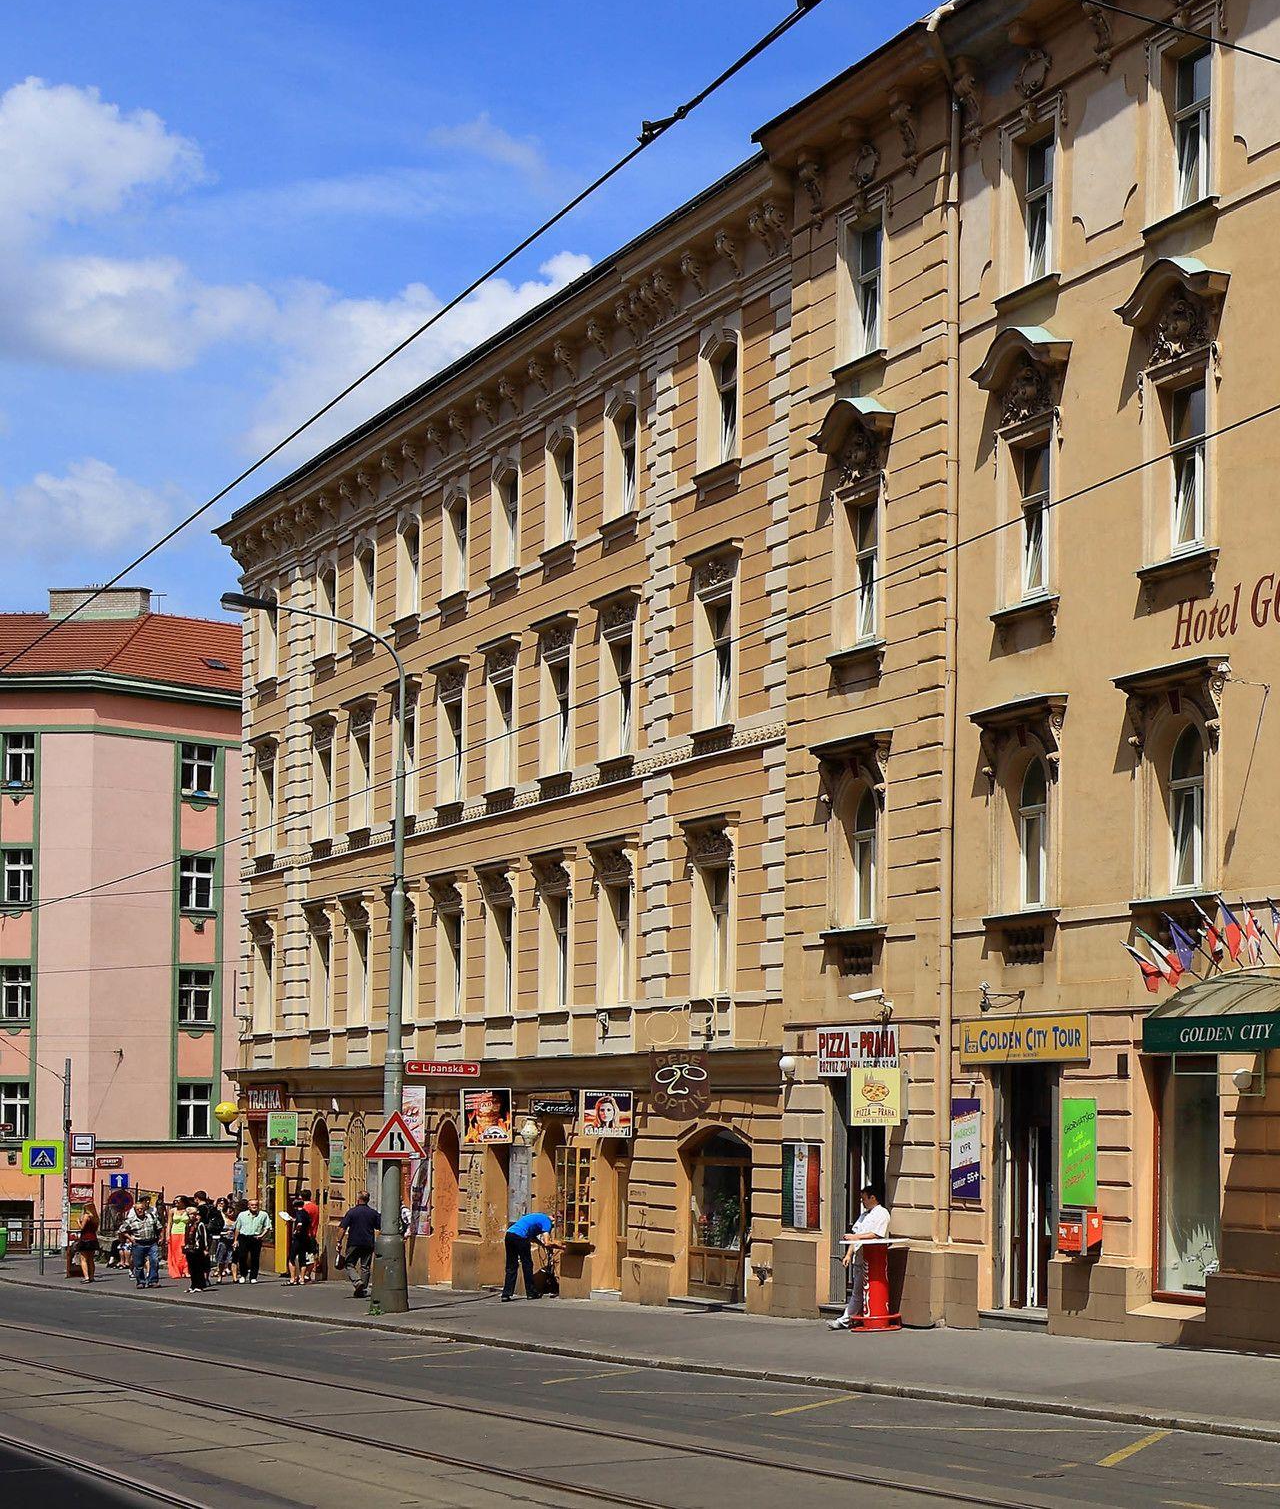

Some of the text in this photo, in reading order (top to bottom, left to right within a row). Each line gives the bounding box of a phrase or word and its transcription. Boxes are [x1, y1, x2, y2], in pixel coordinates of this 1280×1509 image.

[1171, 582, 1241, 650] Hotel
[980, 1025, 1082, 1053] GOLDEN CITY TOUR
[1180, 1026, 1231, 1043] GOLDEN
[1240, 1024, 1273, 1040] CITY
[422, 1064, 464, 1073] Lipanská
[655, 1054, 701, 1068] PEPE
[247, 1089, 282, 1109] TRAFIKA
[654, 1090, 708, 1113] OPTIK
